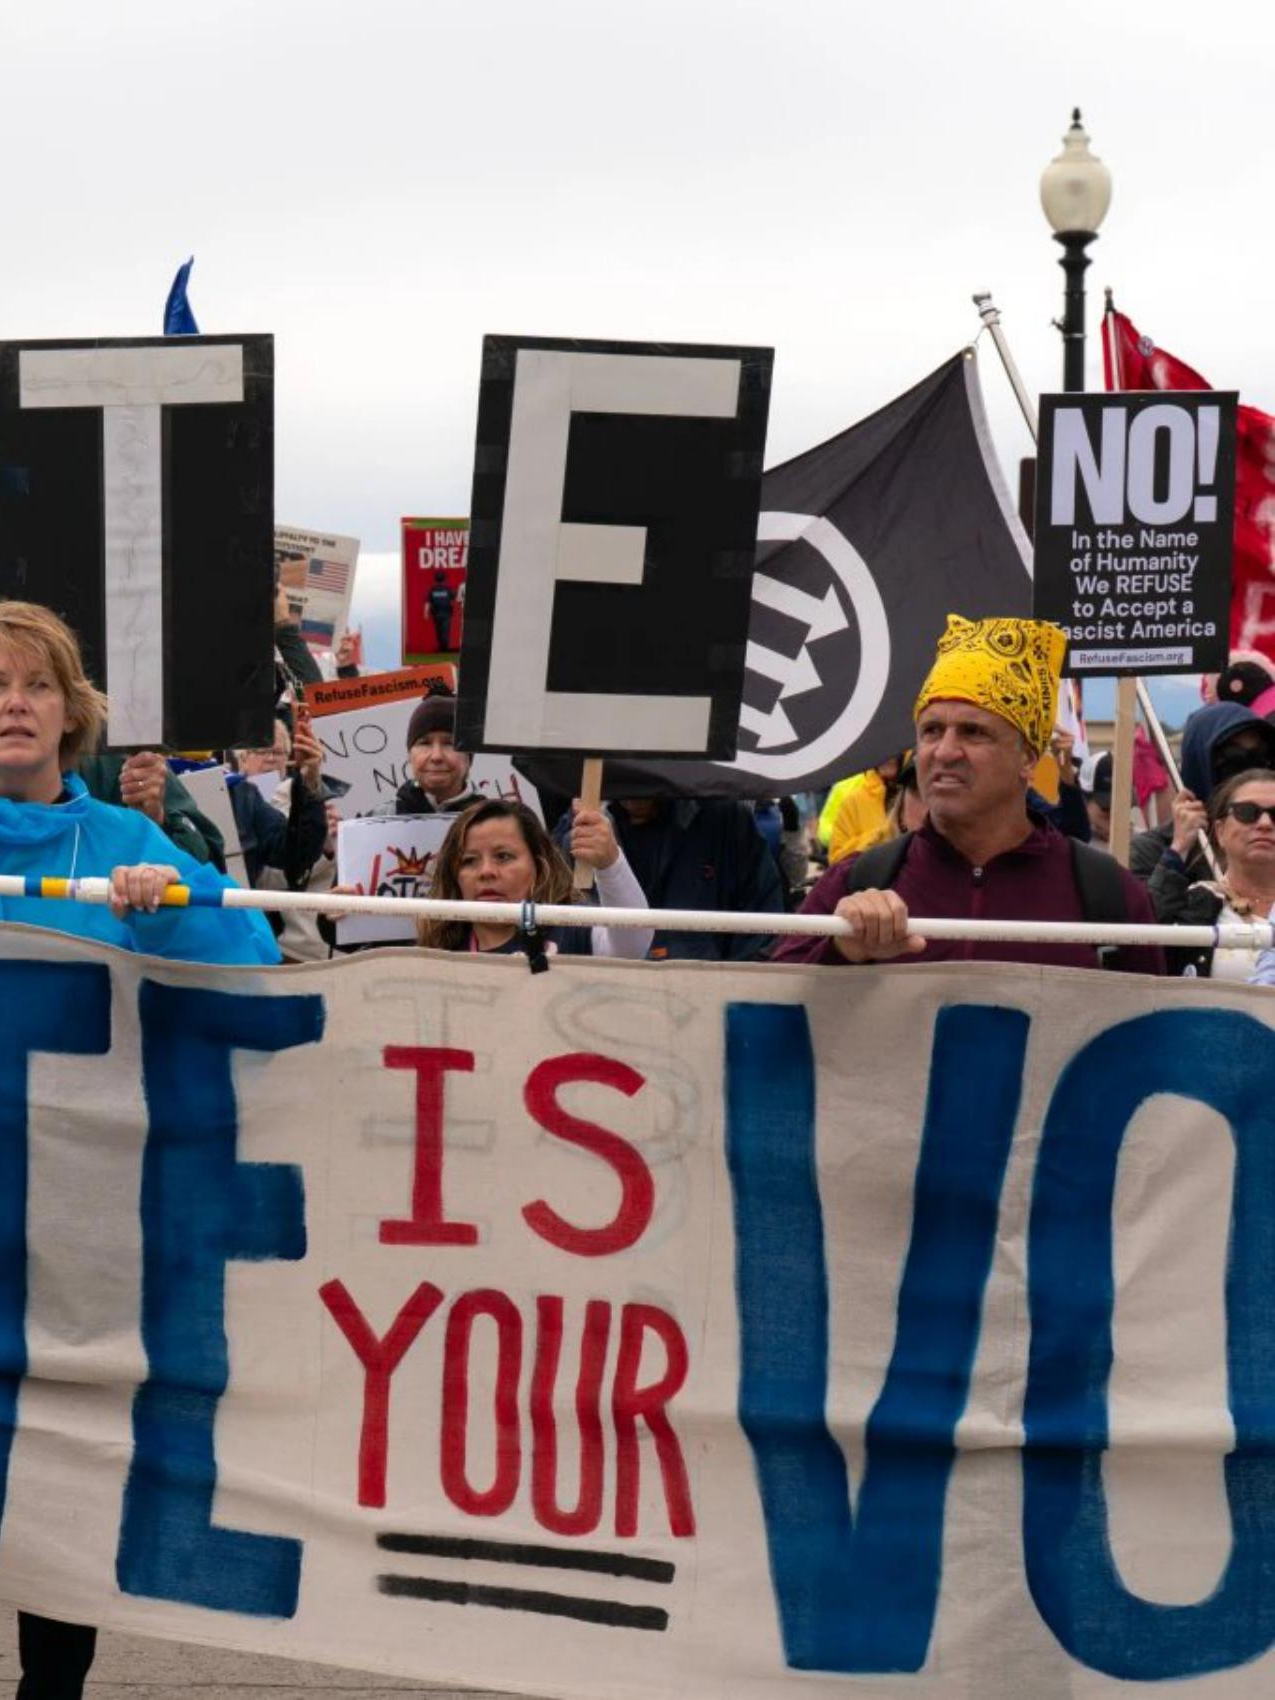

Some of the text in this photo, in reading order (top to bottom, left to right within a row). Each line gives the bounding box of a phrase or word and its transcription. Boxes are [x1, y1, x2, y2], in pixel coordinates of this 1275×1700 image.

[1051, 404, 1220, 526] NO!
[1071, 530, 1199, 549] In the Name
[1070, 551, 1199, 576] of Humanity
[1076, 574, 1193, 595] We REFUSE
[1072, 597, 1194, 620] to Accept a
[1055, 618, 1216, 640] ascist America
[378, 1044, 656, 1258] IS
[723, 1002, 1275, 1683] VO
[317, 1276, 696, 1537] YOUR
